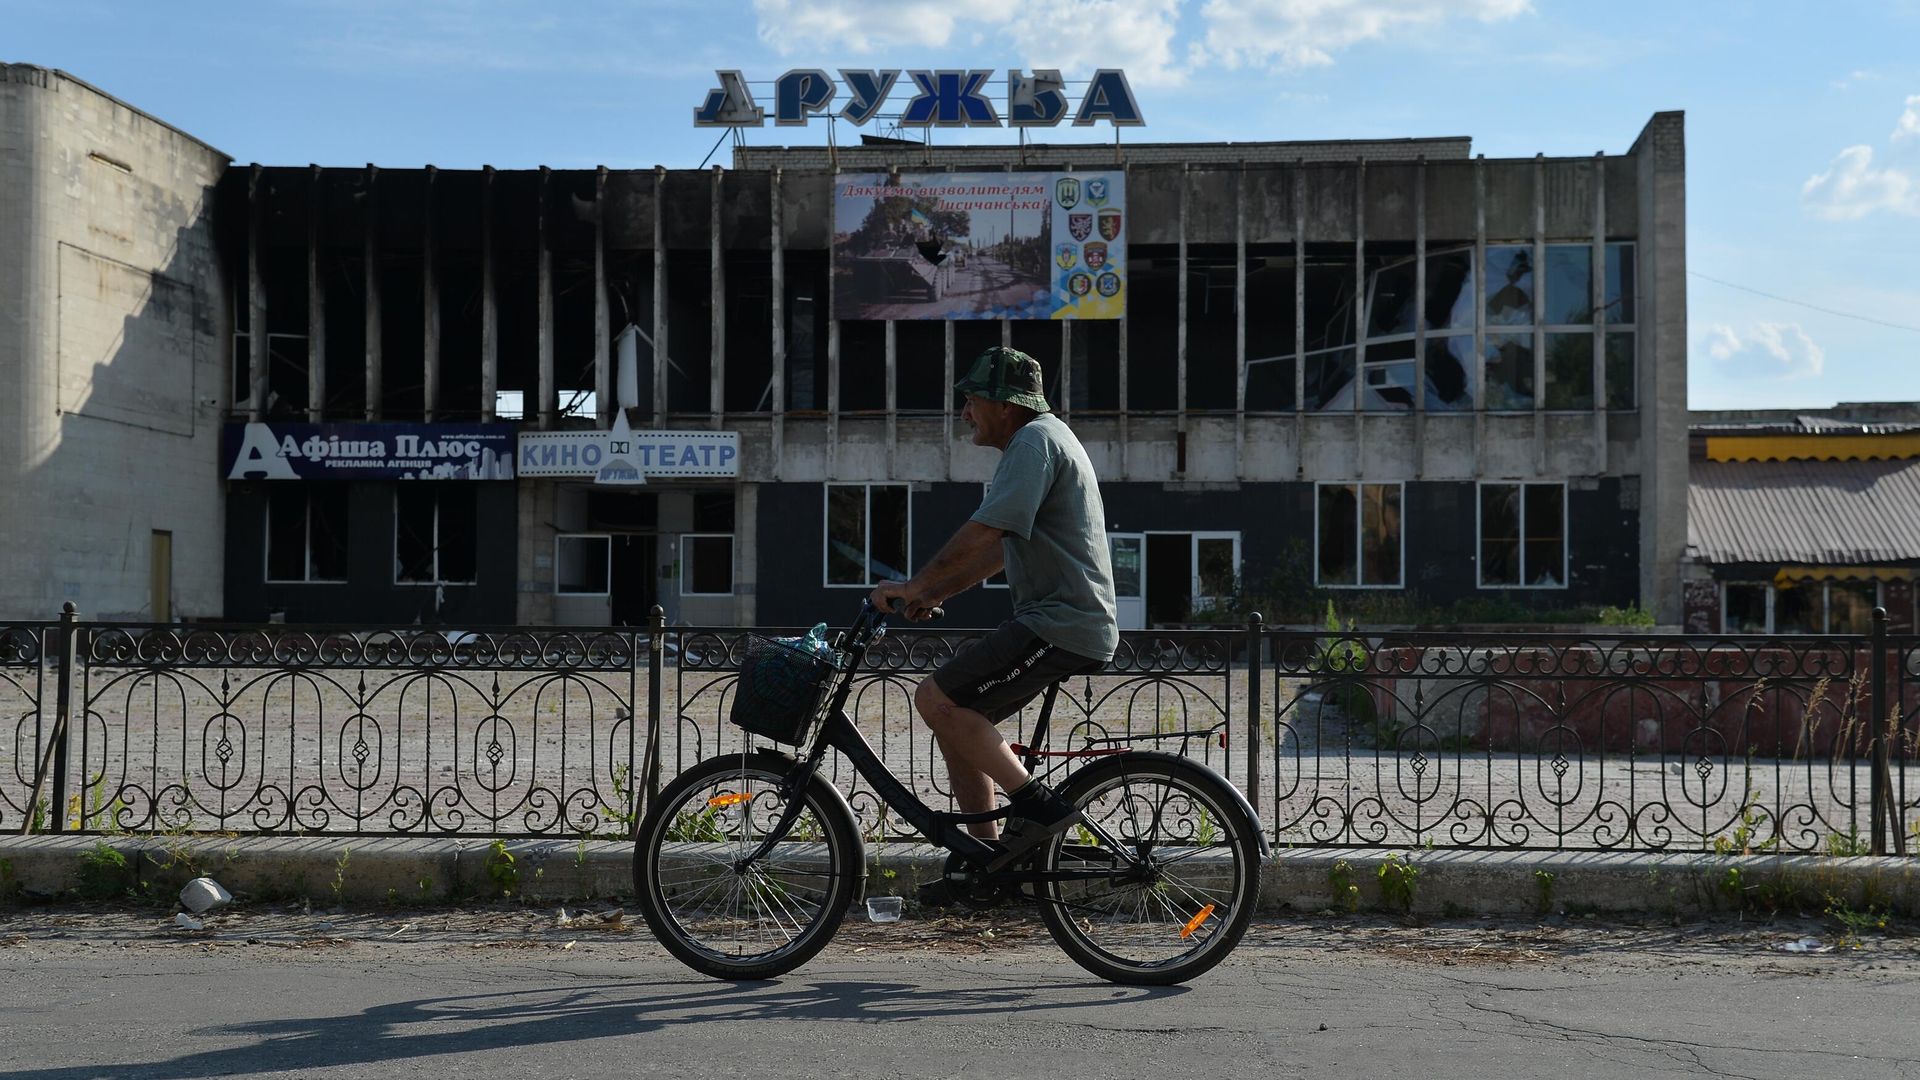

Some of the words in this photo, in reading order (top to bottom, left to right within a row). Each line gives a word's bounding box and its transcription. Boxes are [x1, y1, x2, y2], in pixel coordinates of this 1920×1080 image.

[694, 69, 1146, 127] ДРУЖБА
[842, 184, 914, 197] Дякуємо
[919, 184, 1045, 196] визволителям
[275, 434, 386, 462] Афіша
[395, 435, 481, 458] Плюс
[522, 444, 602, 466] КИНО
[639, 444, 736, 466] ТЕАТР
[325, 459, 384, 468] РЕКЛАМНА
[387, 459, 432, 469] АГЕНЦІЯ
